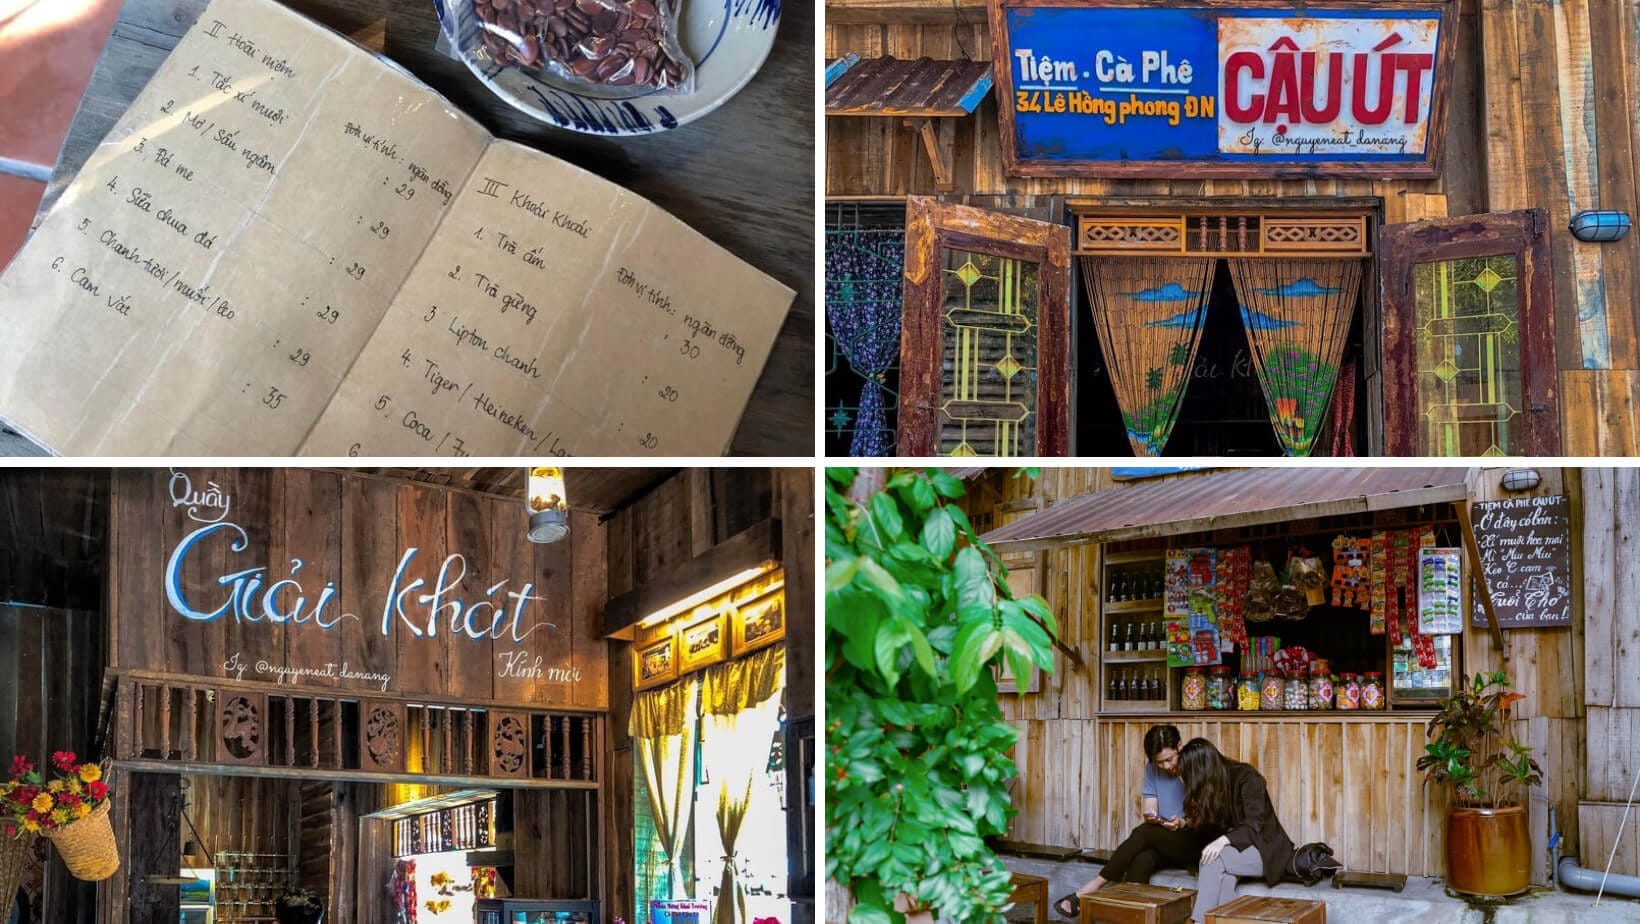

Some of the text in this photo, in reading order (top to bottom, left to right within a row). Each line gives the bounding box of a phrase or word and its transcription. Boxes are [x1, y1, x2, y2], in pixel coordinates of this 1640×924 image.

[203, 20, 227, 38] II
[1015, 48, 1193, 87] Tiệm Cà Phê
[1224, 32, 1433, 135] CẬU ÚT
[211, 71, 232, 94] Tắc
[252, 101, 289, 127] muội
[1016, 90, 1215, 126] 34 Lê Hồng phong ĐN
[155, 148, 174, 168] Đá
[176, 164, 194, 181] me
[213, 129, 240, 150] Sấu
[242, 149, 276, 175] ngâm
[126, 187, 152, 212] Sữa
[156, 209, 188, 236] chua
[194, 232, 217, 249] đá
[476, 177, 592, 238] III Khoái Khoái
[100, 230, 141, 264] Chanh
[498, 232, 518, 255] Trà
[522, 247, 546, 269] ấm
[71, 267, 99, 296] Cam
[475, 273, 500, 298] Trà
[502, 292, 537, 325] gừng
[448, 316, 488, 351] Lipton
[494, 346, 542, 379] chanh
[683, 314, 717, 340] ngàn
[719, 332, 745, 365] đồng
[168, 467, 230, 523] Quầy
[165, 522, 350, 631] Giải
[498, 650, 582, 683] Kính mời
